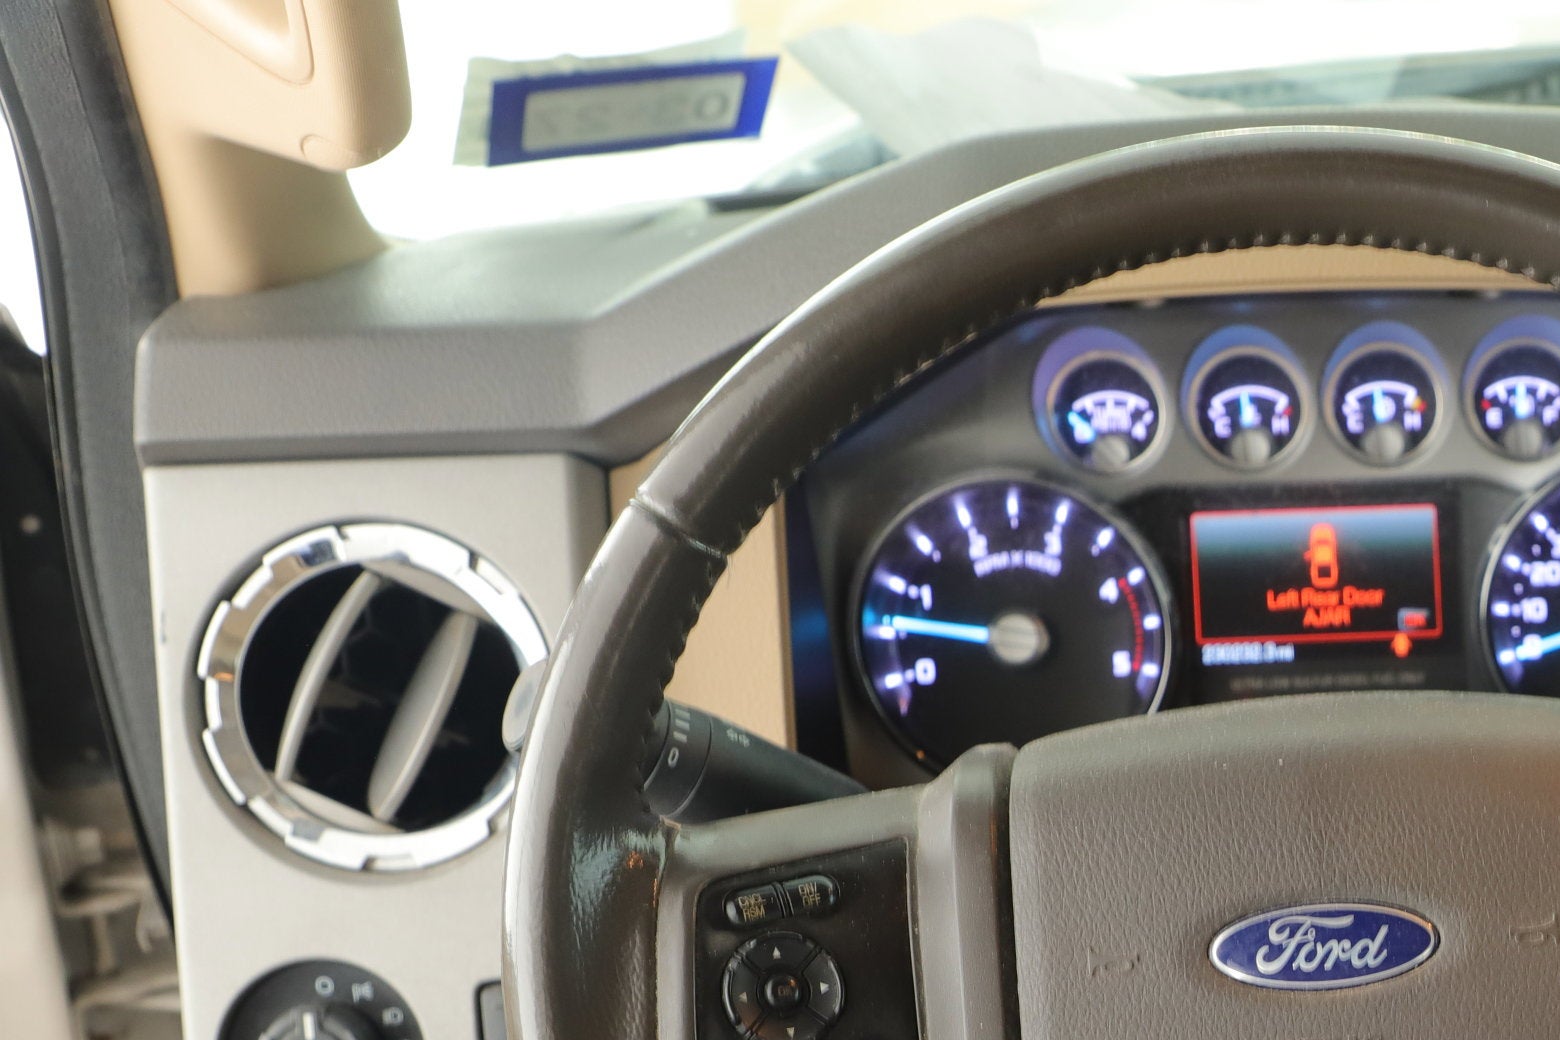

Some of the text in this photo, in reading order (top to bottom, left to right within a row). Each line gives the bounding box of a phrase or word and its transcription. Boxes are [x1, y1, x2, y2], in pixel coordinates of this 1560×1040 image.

[1099, 577, 1119, 604] 4
[1266, 588, 1299, 612] Left
[1342, 585, 1384, 608] Door
[1302, 607, 1351, 628] AJAR
[1519, 596, 1548, 624] 10
[914, 656, 937, 686] 0
[1255, 913, 1389, 975] Ford
